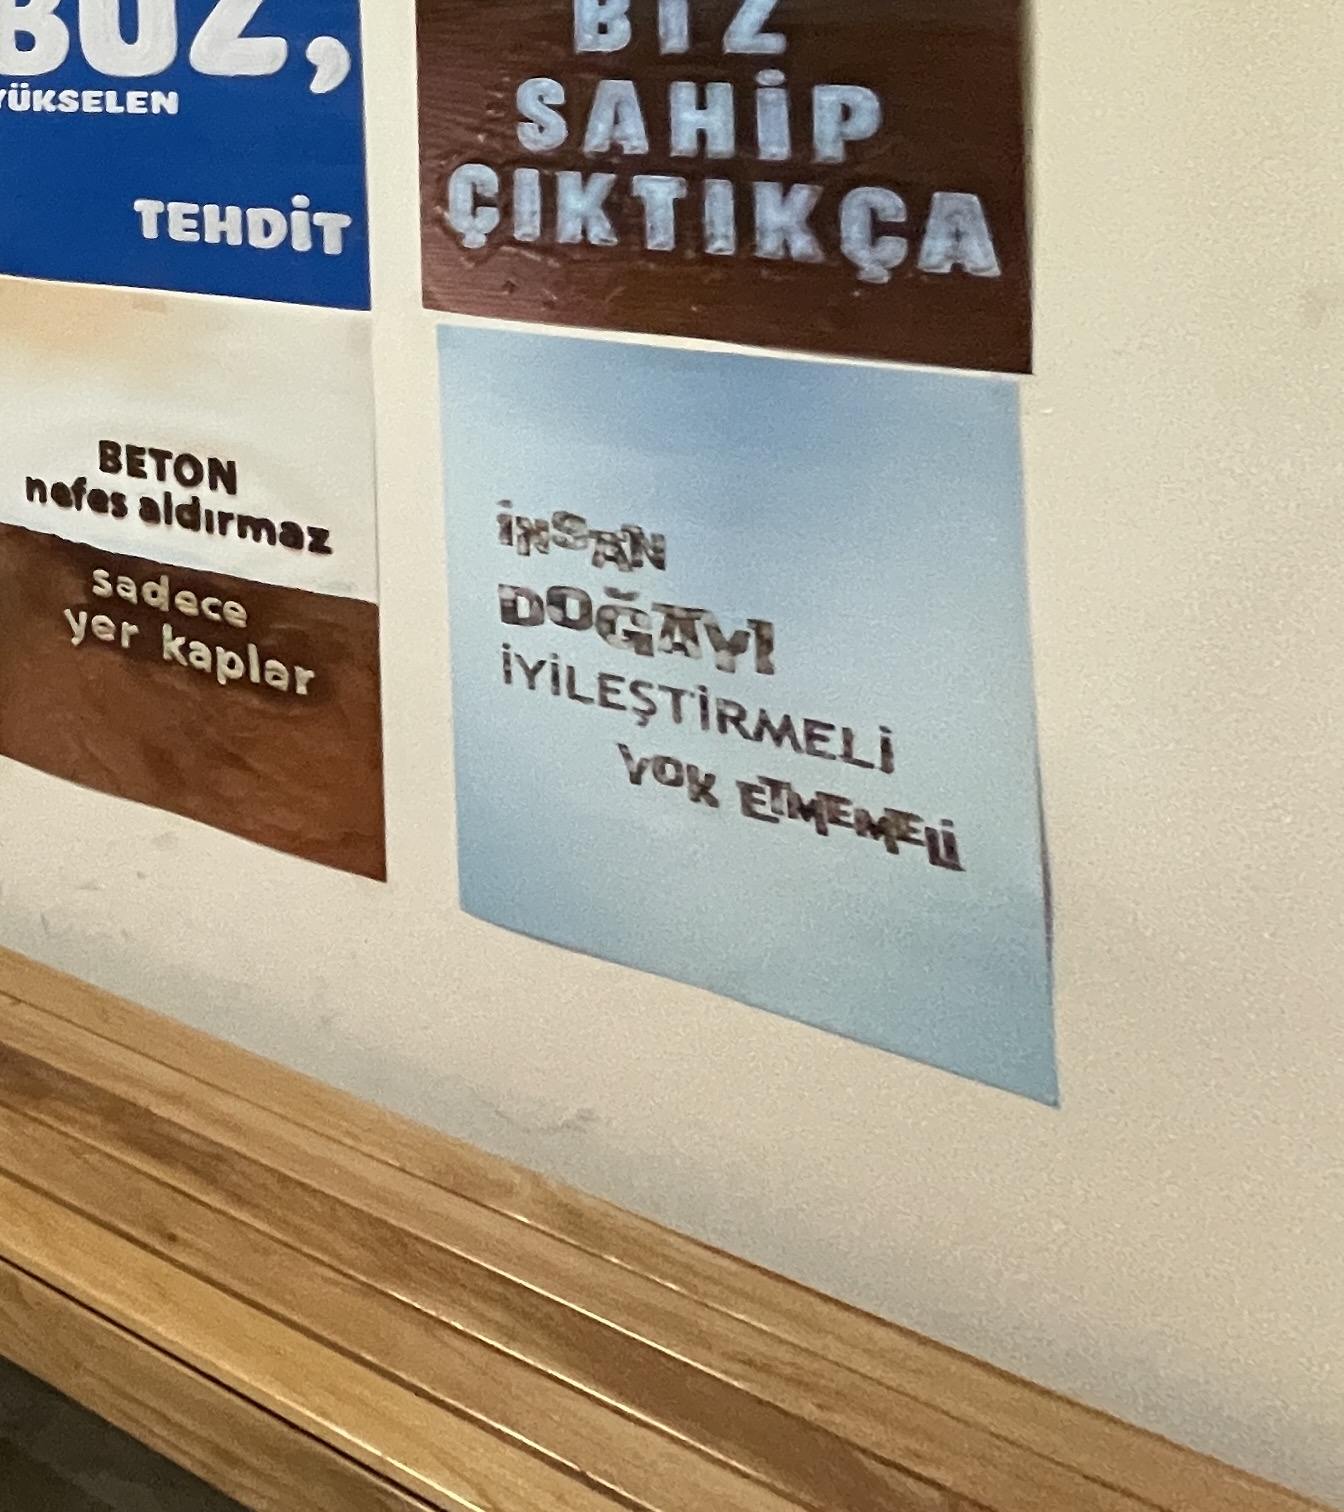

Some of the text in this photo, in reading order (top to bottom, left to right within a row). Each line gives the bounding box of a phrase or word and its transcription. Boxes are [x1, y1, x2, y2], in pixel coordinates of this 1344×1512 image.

[515, 69, 882, 163] SAHİP
[134, 195, 352, 255] TEHDİT
[445, 163, 1002, 283] ÇIKTIKÇA
[98, 439, 237, 496] BETON
[26, 474, 333, 556] nefes aldırmaz
[495, 498, 667, 572] İNSAN
[91, 567, 249, 629] sadece
[497, 583, 776, 675] DOĞAYI
[63, 607, 316, 695] yer kaplar
[500, 642, 895, 774] İYİLEŞTİRMELİ
[616, 742, 966, 872] YOK ETMEMELİ
